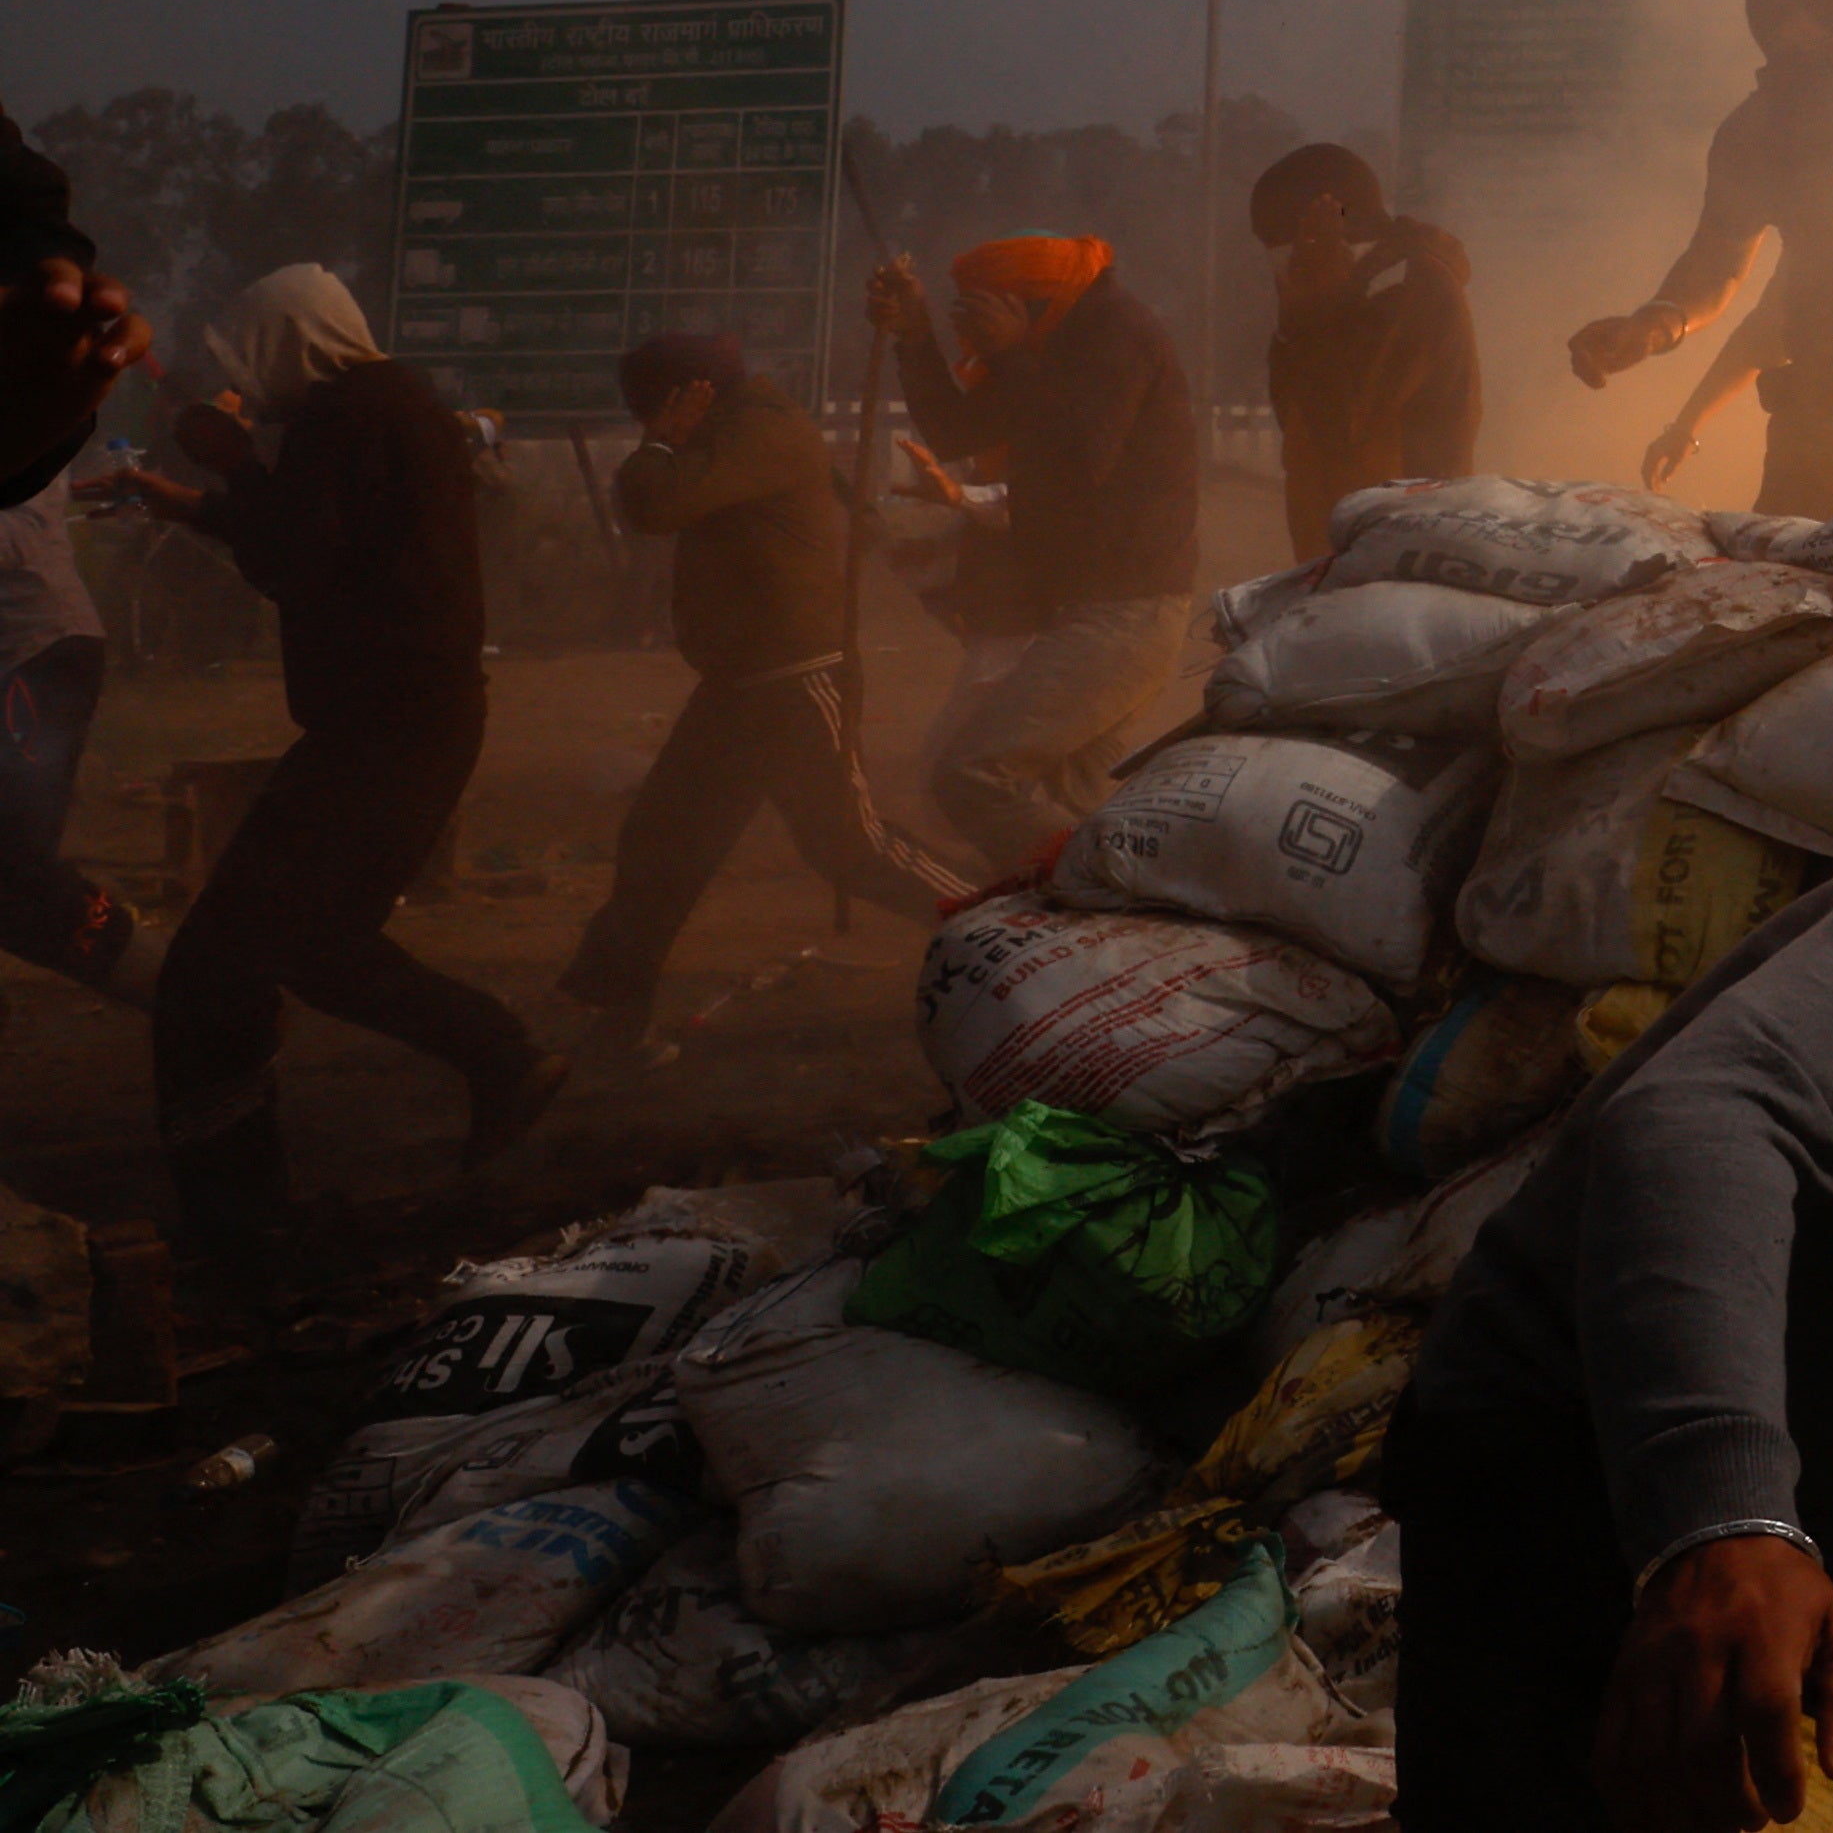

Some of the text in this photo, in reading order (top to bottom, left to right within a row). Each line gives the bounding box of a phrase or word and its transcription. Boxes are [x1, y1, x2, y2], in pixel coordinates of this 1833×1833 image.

[1654, 830, 1699, 980] OT FOR
[989, 943, 1074, 1003] BUILD
[1070, 1690, 1158, 1728] FOR
[955, 1727, 1087, 1826] RETA
